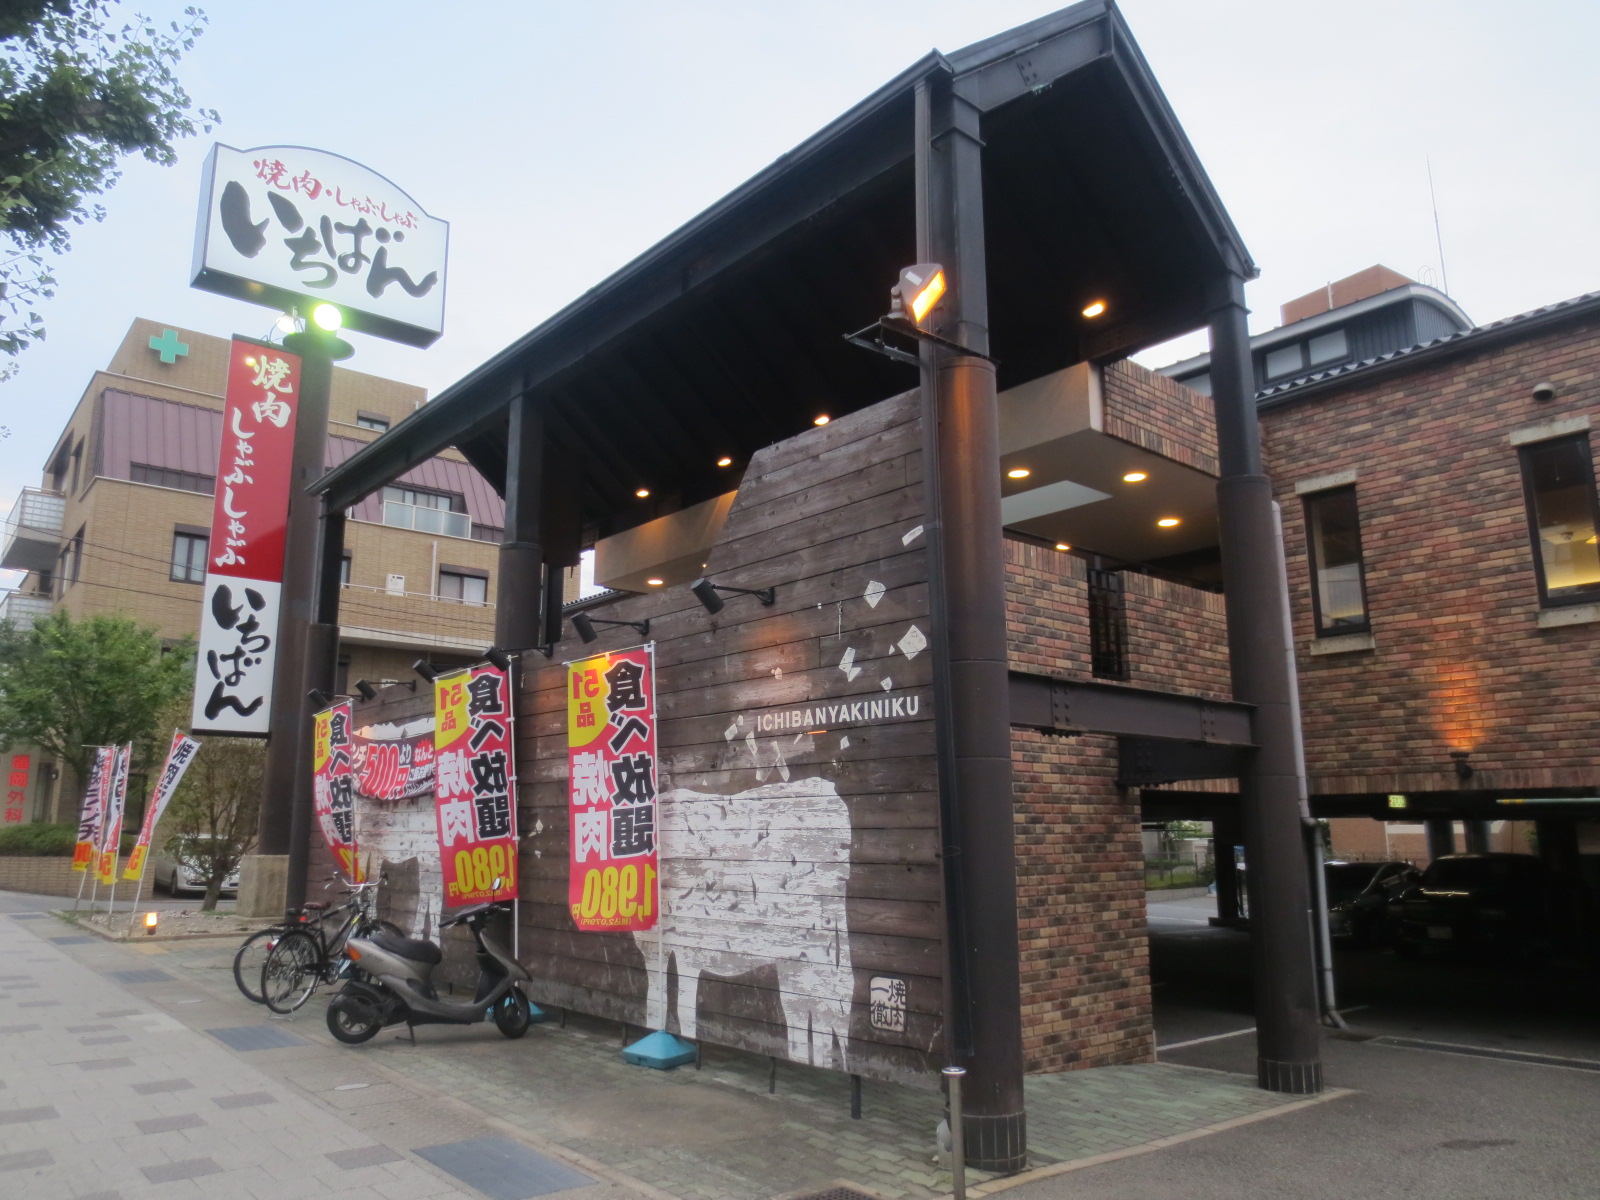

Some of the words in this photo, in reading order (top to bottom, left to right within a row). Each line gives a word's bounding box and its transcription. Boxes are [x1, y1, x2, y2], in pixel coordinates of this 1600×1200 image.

[220, 180, 439, 299] いちばん
[251, 355, 294, 428] 焼肉
[215, 406, 256, 567] しゃぶしゃぶ
[204, 583, 272, 722] いちばん
